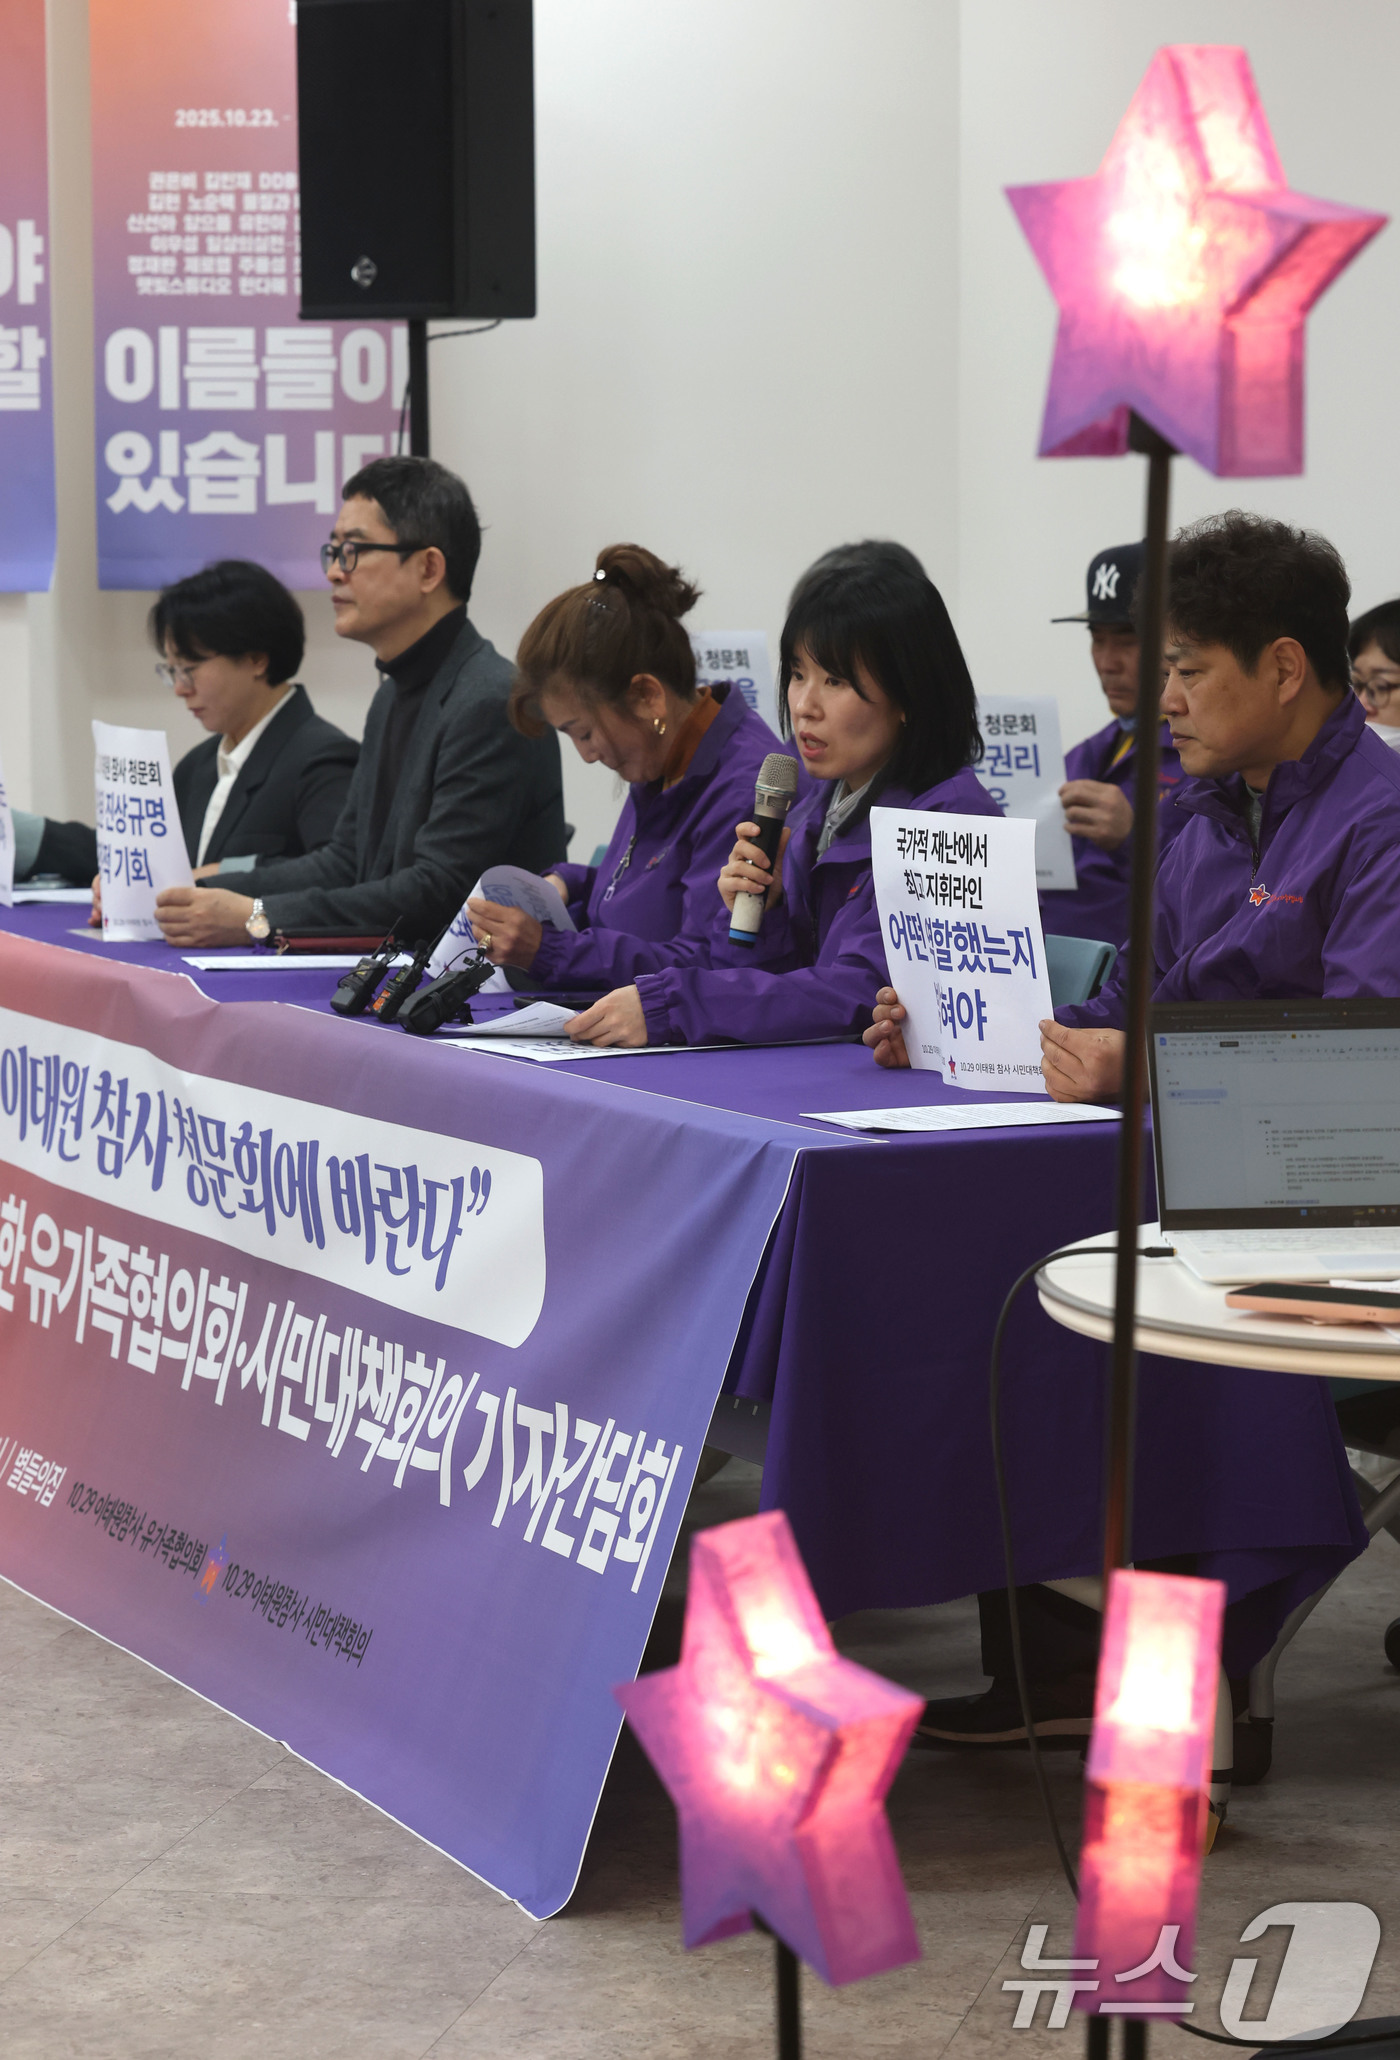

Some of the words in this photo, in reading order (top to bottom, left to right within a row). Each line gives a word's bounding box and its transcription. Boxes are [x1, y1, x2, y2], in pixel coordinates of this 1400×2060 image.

[105, 326, 409, 410] 이름들이
[985, 713, 1037, 736] 청문회
[129, 760, 162, 787] 청문회
[115, 846, 153, 888] 기회
[897, 827, 929, 862] 국가적
[931, 830, 988, 868] 재난에서
[903, 869, 926, 901] 최고
[925, 872, 984, 909] 지휘라인
[889, 910, 929, 962] 어떤
[1, 1045, 90, 1162] 이태원
[90, 1070, 173, 1192] 참사
[172, 1097, 326, 1250] 청문회에
[6, 1447, 67, 1508] 별들의집
[463, 1386, 683, 1594] 기자간담회
[139, 1520, 209, 1580] 유가족협의회
[302, 1602, 374, 1669] 시민대책회의
